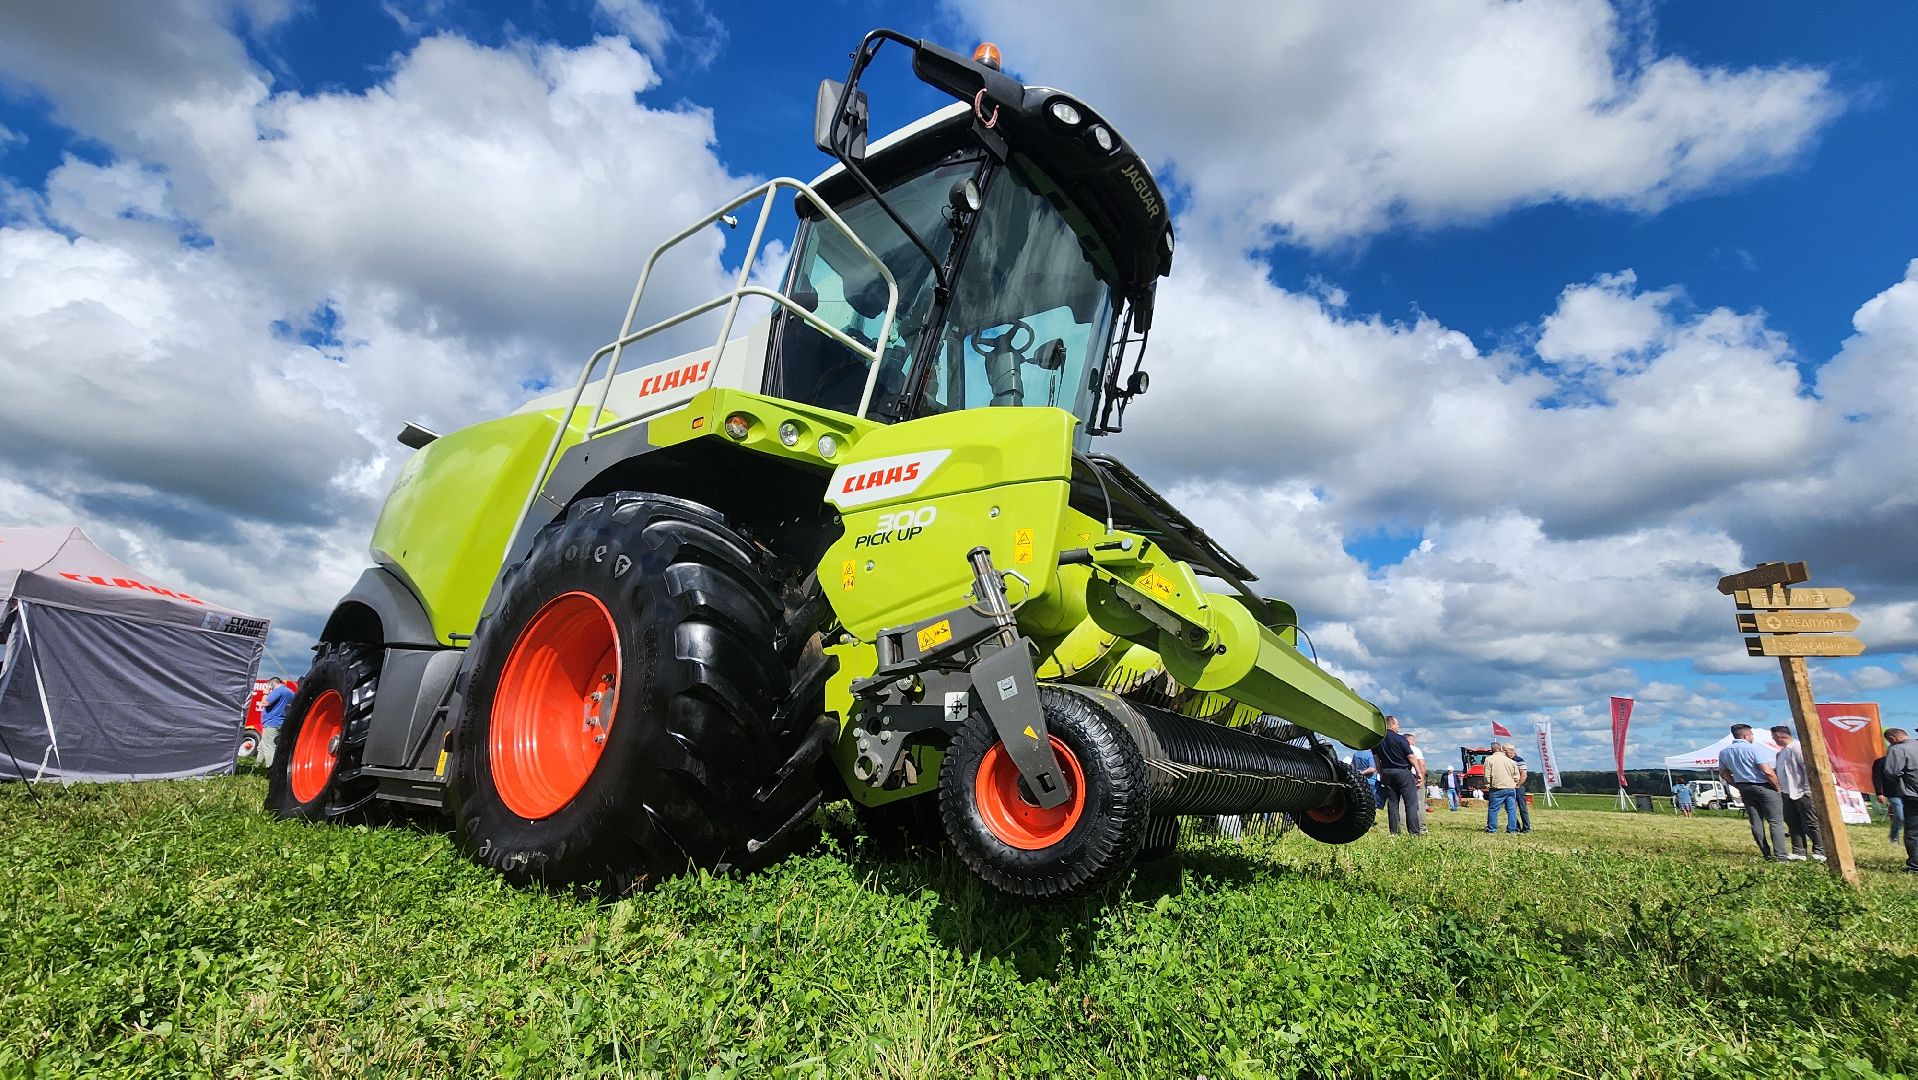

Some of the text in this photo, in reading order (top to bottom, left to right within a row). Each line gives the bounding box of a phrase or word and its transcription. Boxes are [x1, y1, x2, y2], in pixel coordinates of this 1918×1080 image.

[1121, 164, 1159, 218] JAGUAR
[639, 360, 711, 397] CLAAS
[842, 462, 920, 493] CLAAS
[876, 506, 937, 533] 300
[855, 526, 923, 549] PICK UP
[1788, 593, 1826, 603] УАЛЕТ
[1785, 618, 1843, 628] МЕДПУНКТ
